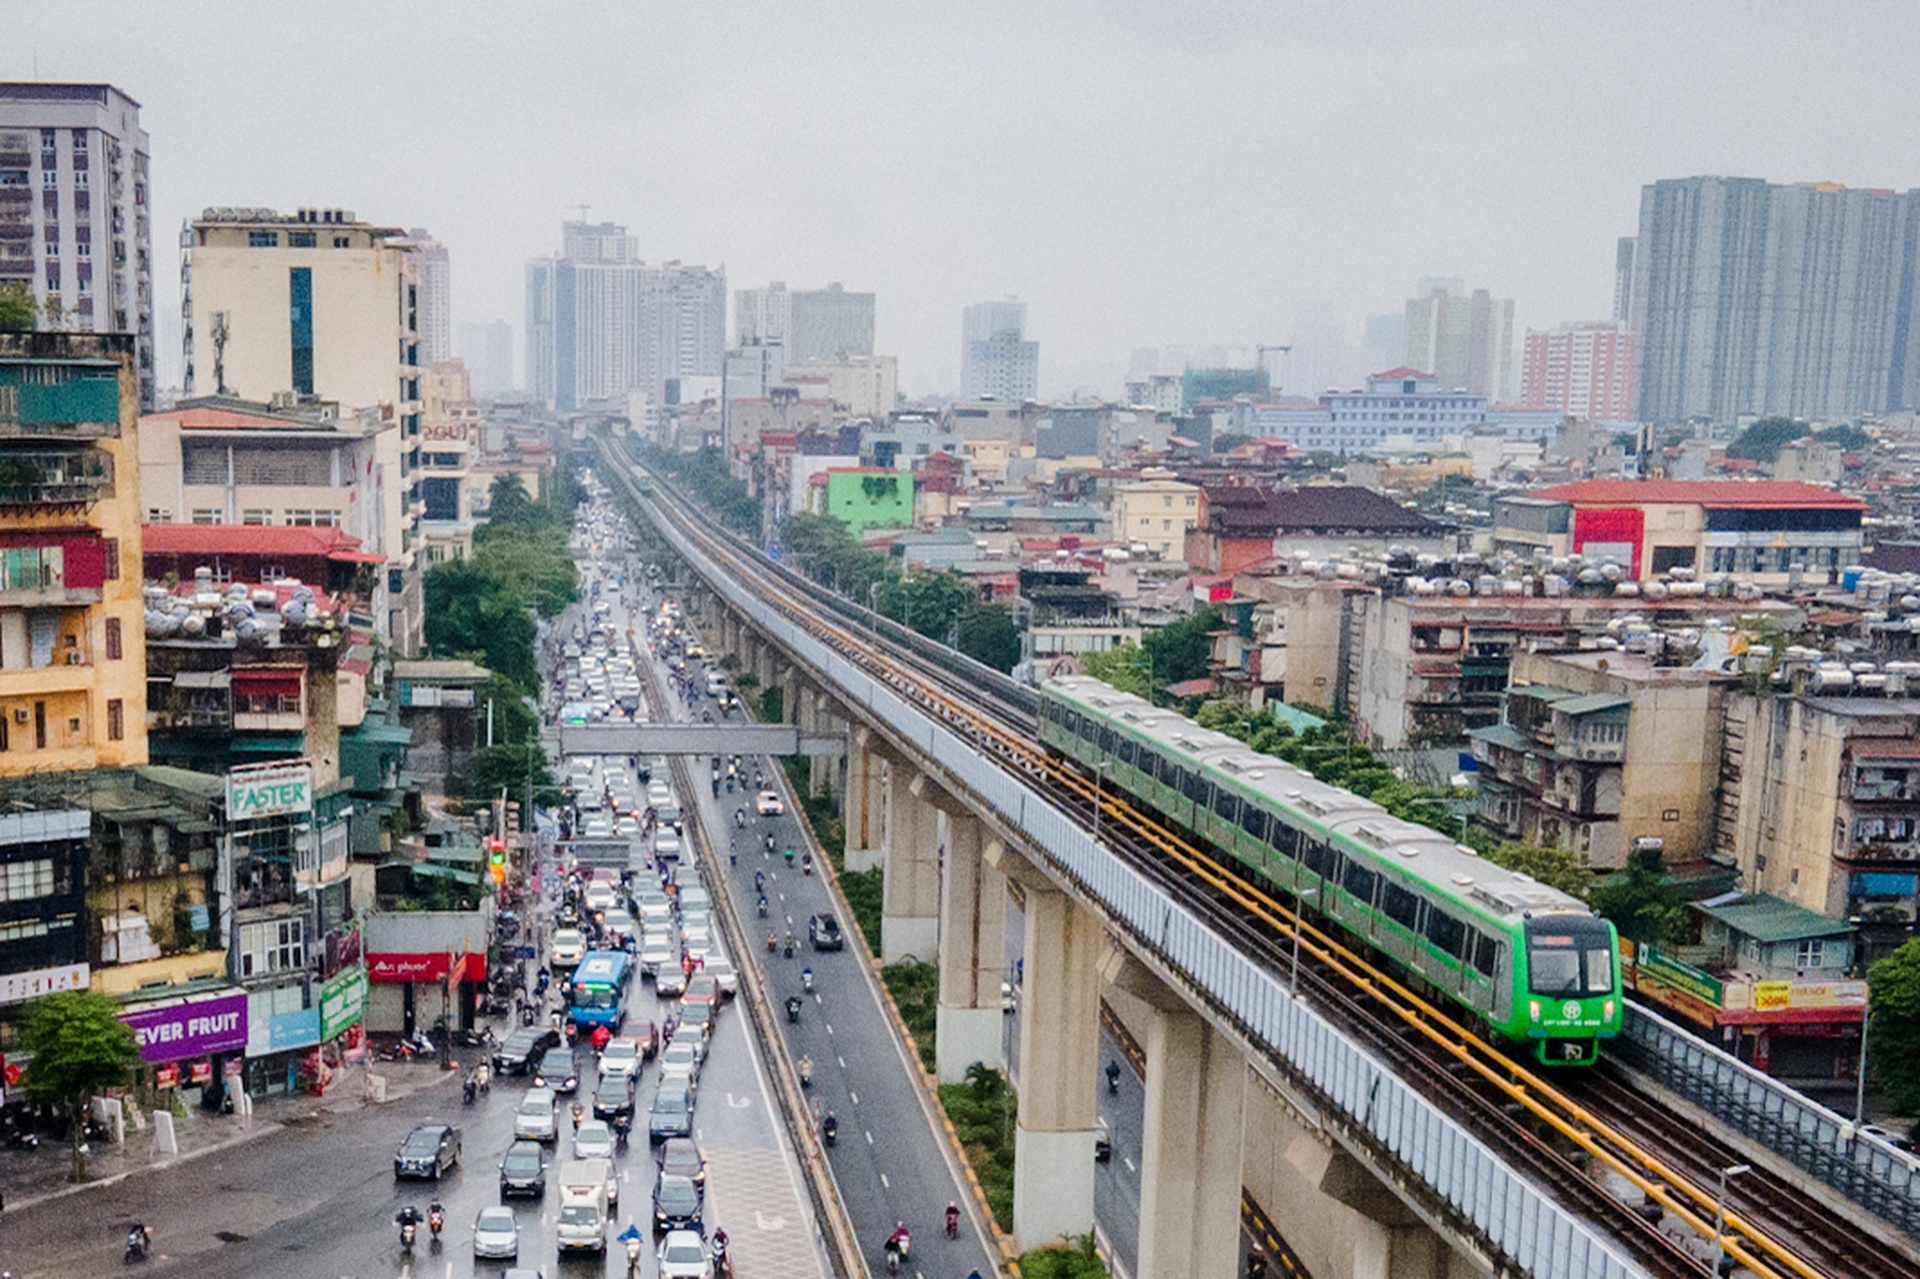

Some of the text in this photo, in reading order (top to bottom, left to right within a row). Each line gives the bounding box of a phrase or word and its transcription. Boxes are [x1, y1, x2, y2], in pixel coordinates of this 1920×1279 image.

[233, 782, 305, 812] FASTER
[134, 1021, 184, 1046] EVER
[187, 1012, 240, 1038] FRUIT
